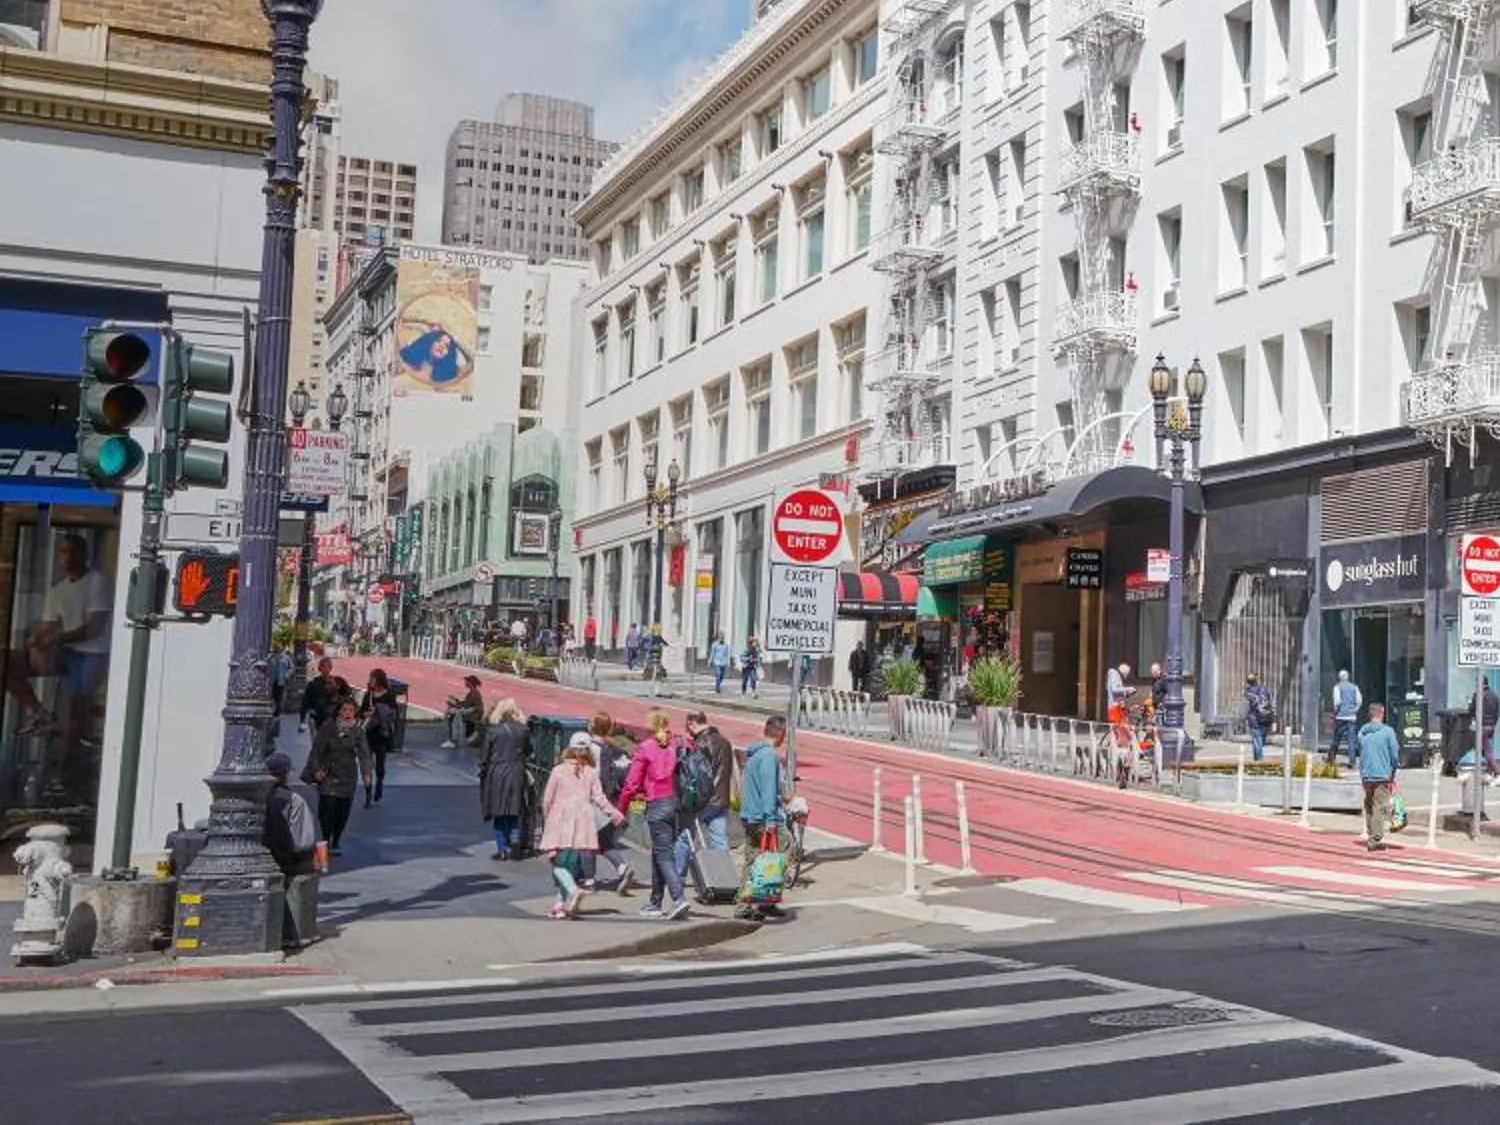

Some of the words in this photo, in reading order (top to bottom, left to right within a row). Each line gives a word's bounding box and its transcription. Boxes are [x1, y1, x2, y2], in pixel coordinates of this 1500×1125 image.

[785, 502, 803, 516] DO
[809, 504, 834, 518] NOT
[787, 536, 827, 550] ENTER
[1469, 546, 1481, 557] DO
[1484, 547, 1500, 559] NOT
[784, 568, 824, 583] EXCEPT
[1345, 556, 1395, 586] sunglass
[1397, 554, 1418, 575] hut
[1471, 573, 1497, 585] ENTER
[790, 586, 817, 600] MUNI
[787, 602, 817, 616] TAXIS
[770, 618, 829, 633] COMMERCIAL
[775, 634, 825, 649] VEHICLES
